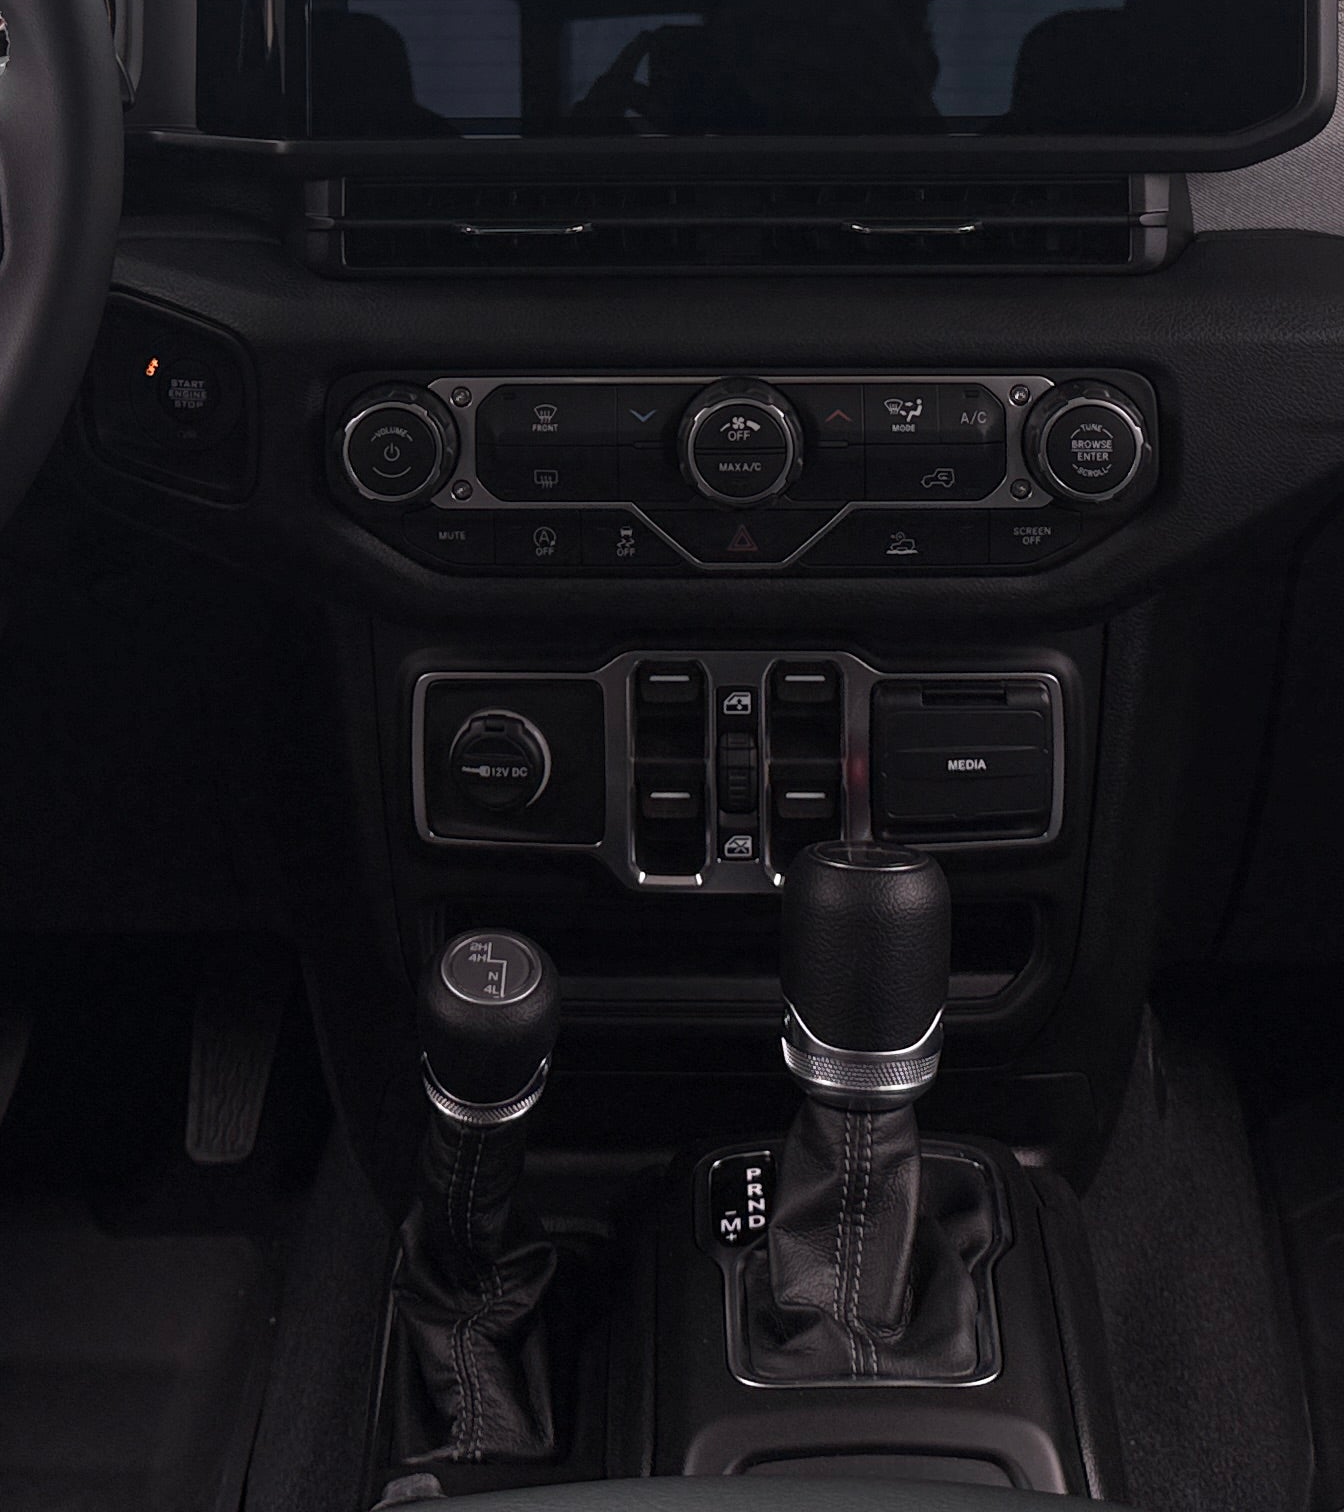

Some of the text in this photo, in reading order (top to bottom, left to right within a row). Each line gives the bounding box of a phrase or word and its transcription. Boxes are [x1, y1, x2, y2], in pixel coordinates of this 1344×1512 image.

[171, 379, 205, 388] START
[168, 390, 207, 399] ENGINE
[174, 400, 204, 409] STOP
[960, 411, 987, 425] A/C
[374, 425, 409, 439] VOLUME
[532, 423, 558, 433] FRONT
[892, 424, 916, 433] MODE
[1080, 423, 1104, 433] TUNE
[728, 430, 751, 441] OFF
[1071, 439, 1113, 450] BROWSE
[1077, 452, 1109, 462] ENTER
[719, 462, 762, 472] MAX A/C
[1076, 465, 1110, 478] SCROLL
[439, 531, 466, 540] MUTE
[1013, 526, 1052, 536] SCREEN
[1022, 536, 1041, 545] OFF
[536, 547, 555, 556] OFF
[616, 547, 636, 557] OFF
[947, 759, 987, 771] MEDIA
[490, 767, 528, 778] 12V DC
[471, 942, 488, 952] 2H
[468, 953, 487, 963] 4H
[488, 971, 499, 981] N
[484, 984, 499, 994] 4L
[746, 1168, 761, 1181] P
[747, 1183, 763, 1196] R
[748, 1198, 765, 1213] N
[720, 1217, 741, 1233] M
[748, 1215, 766, 1229] D
